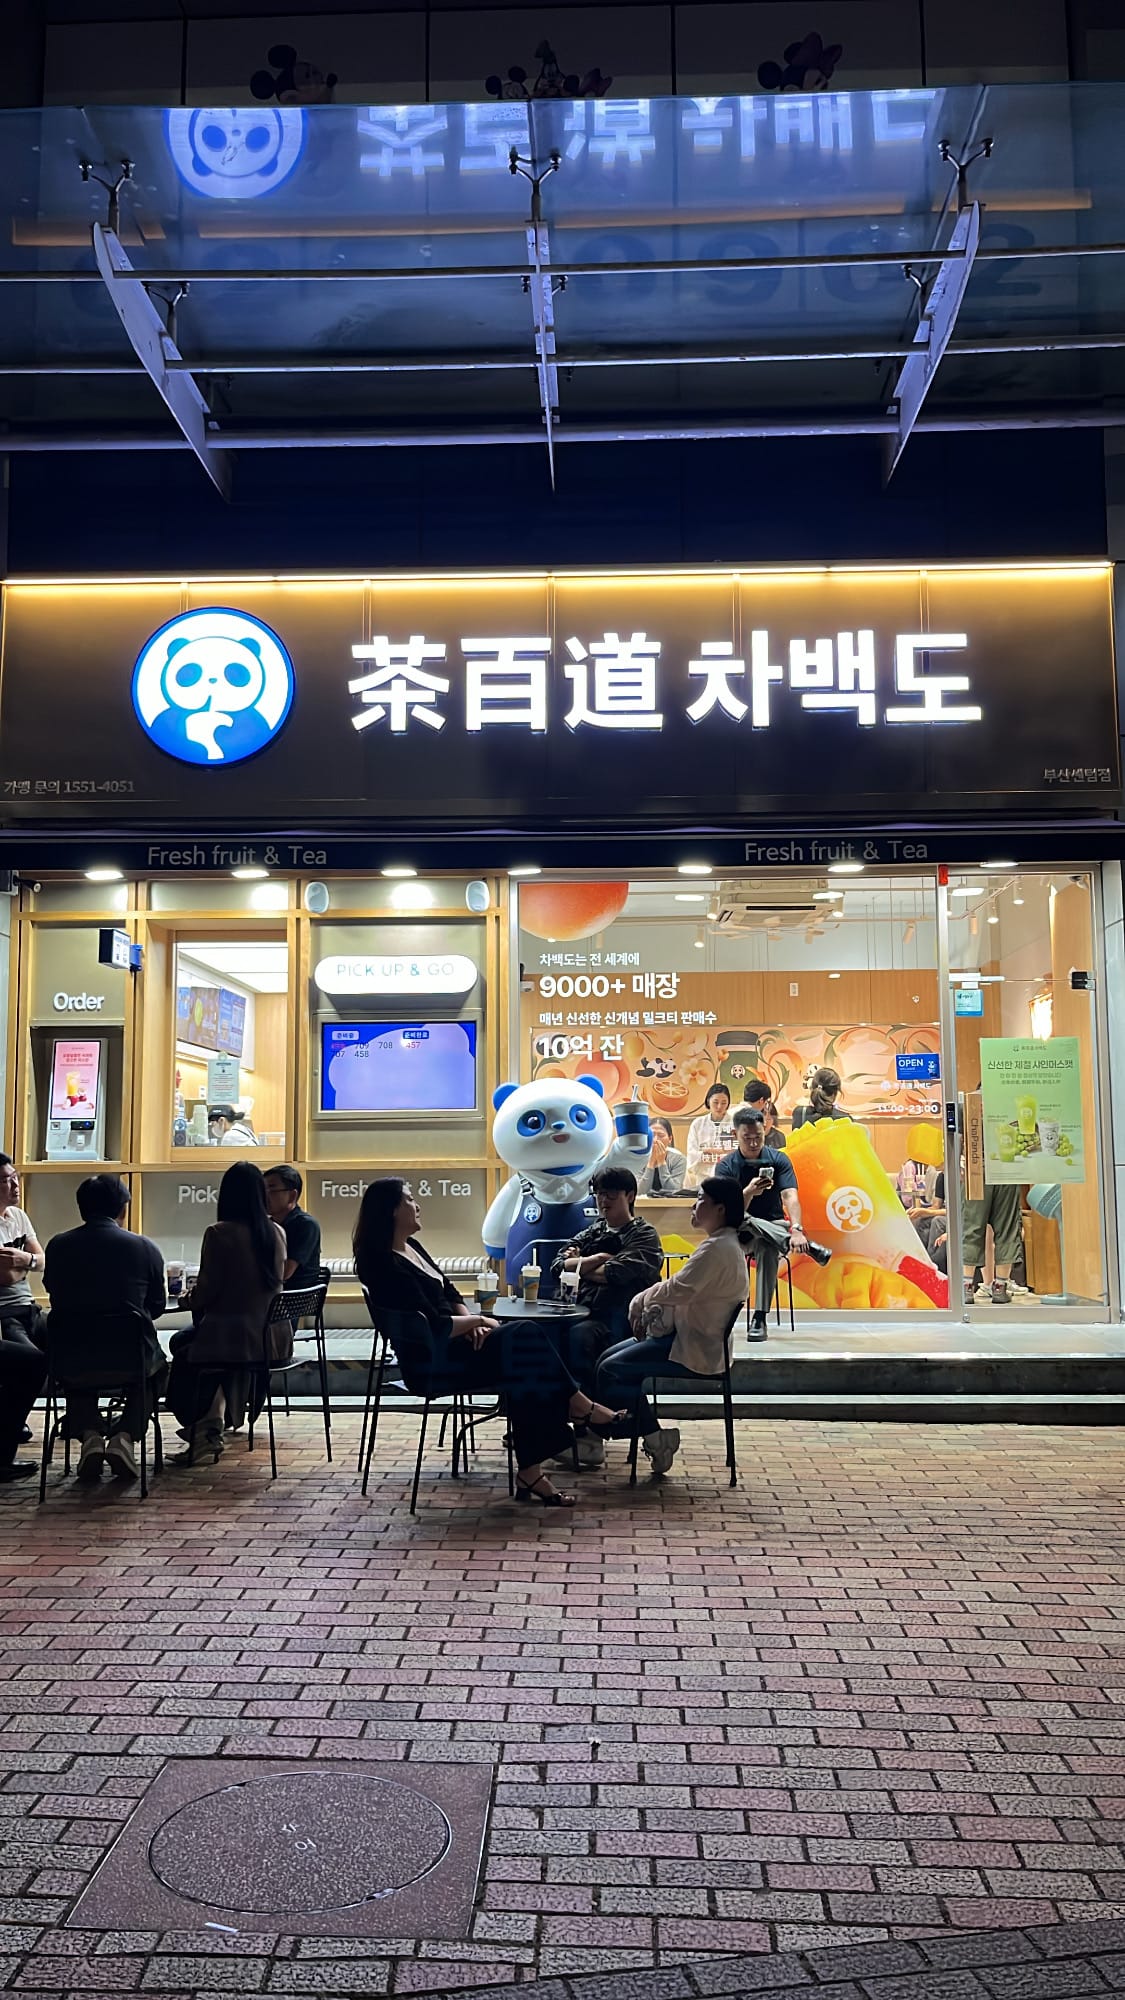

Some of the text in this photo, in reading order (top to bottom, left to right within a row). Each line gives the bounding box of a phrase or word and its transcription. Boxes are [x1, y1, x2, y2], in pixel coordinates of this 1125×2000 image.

[348, 629, 983, 735] 茶百道 차백도
[1044, 767, 1111, 783] 부산센텀점
[4, 780, 136, 794] 가맹 문의 1551-4051
[148, 845, 327, 865] Fresh fruit & Tea
[745, 841, 928, 861] Fresh fruit & Tea
[539, 952, 640, 967] 차백도는 전 세계에
[337, 962, 455, 976] PICK UP & GO
[539, 972, 681, 999] 9000+ 매장
[53, 992, 105, 1011] Order
[539, 1010, 718, 1026] 매년 신선한 신개념 밀크티 판매수
[379, 1041, 393, 1049] 708
[539, 1033, 625, 1061] 10억 잔
[898, 1058, 924, 1068] OPEN
[987, 1060, 1013, 1070] 신선한
[971, 1118, 979, 1165] ChaPanda
[178, 1185, 217, 1203] Pick
[321, 1180, 369, 1197] Fresh
[418, 1180, 433, 1197] &
[438, 1180, 471, 1197] Tea
